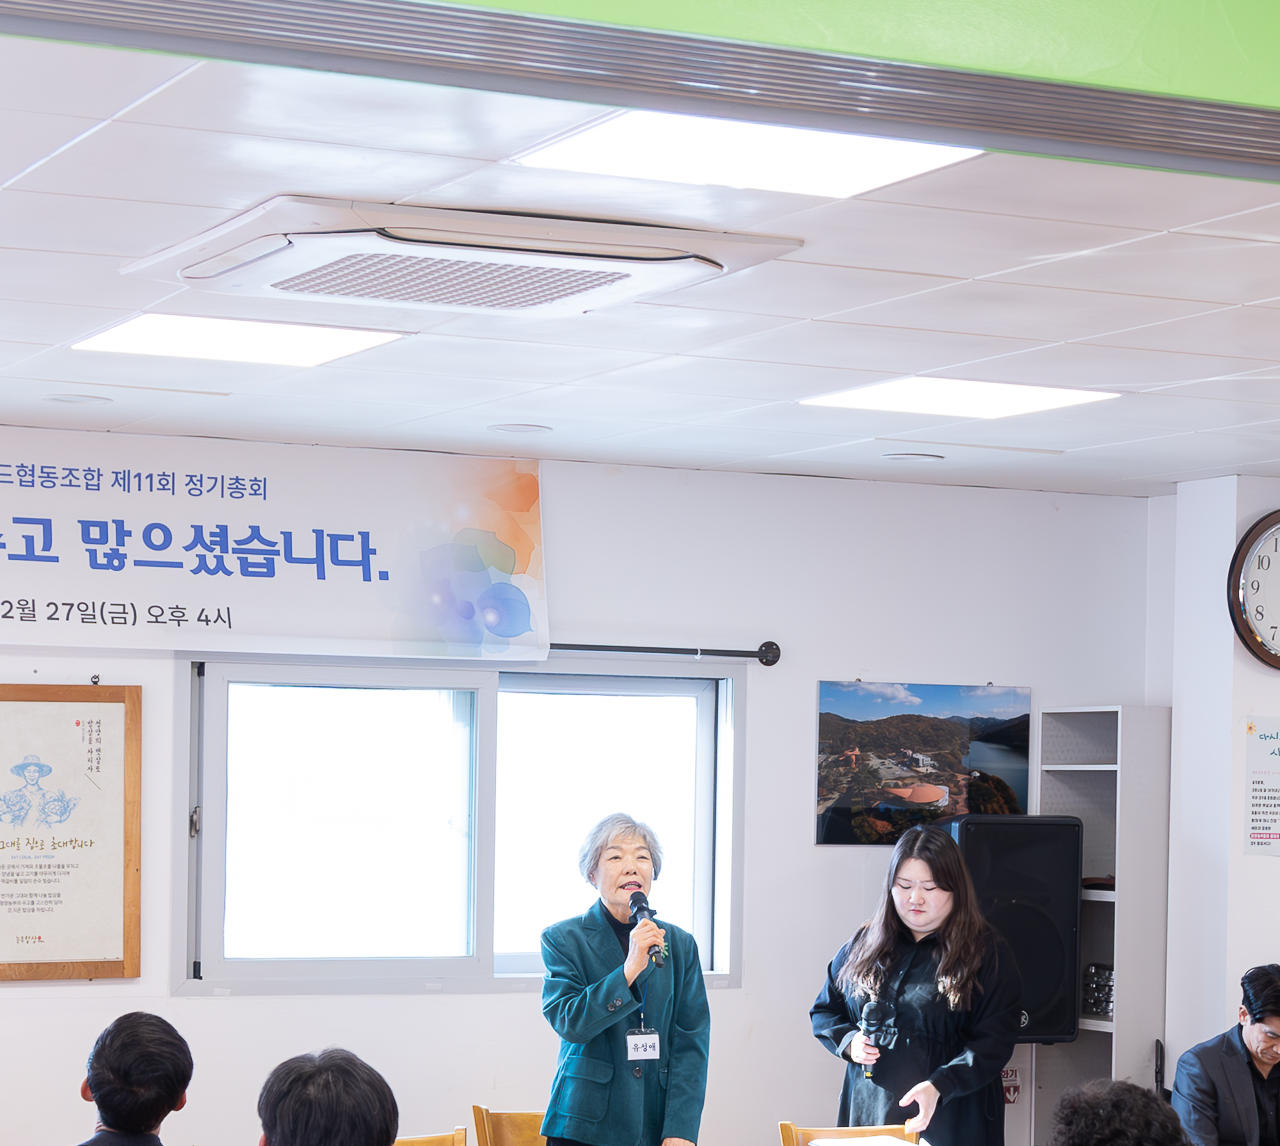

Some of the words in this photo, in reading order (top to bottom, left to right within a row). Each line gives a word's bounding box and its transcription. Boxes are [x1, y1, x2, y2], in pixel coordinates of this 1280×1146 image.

[110, 469, 176, 496] 제11회
[184, 473, 268, 501] 정기총회
[77, 518, 390, 583] 많으셨습니다.
[1257, 554, 1271, 571] 10
[1250, 579, 1260, 596] 9
[0, 598, 37, 622] 2월
[45, 601, 138, 627] 27일(금)
[146, 605, 189, 628] 오후
[196, 606, 232, 630] 4시
[1254, 604, 1264, 622] 8
[1270, 625, 1278, 641] 7
[25, 837, 45, 850] 집으로
[50, 836, 95, 850] 초대합니다
[1000, 1069, 1018, 1079] 화기
